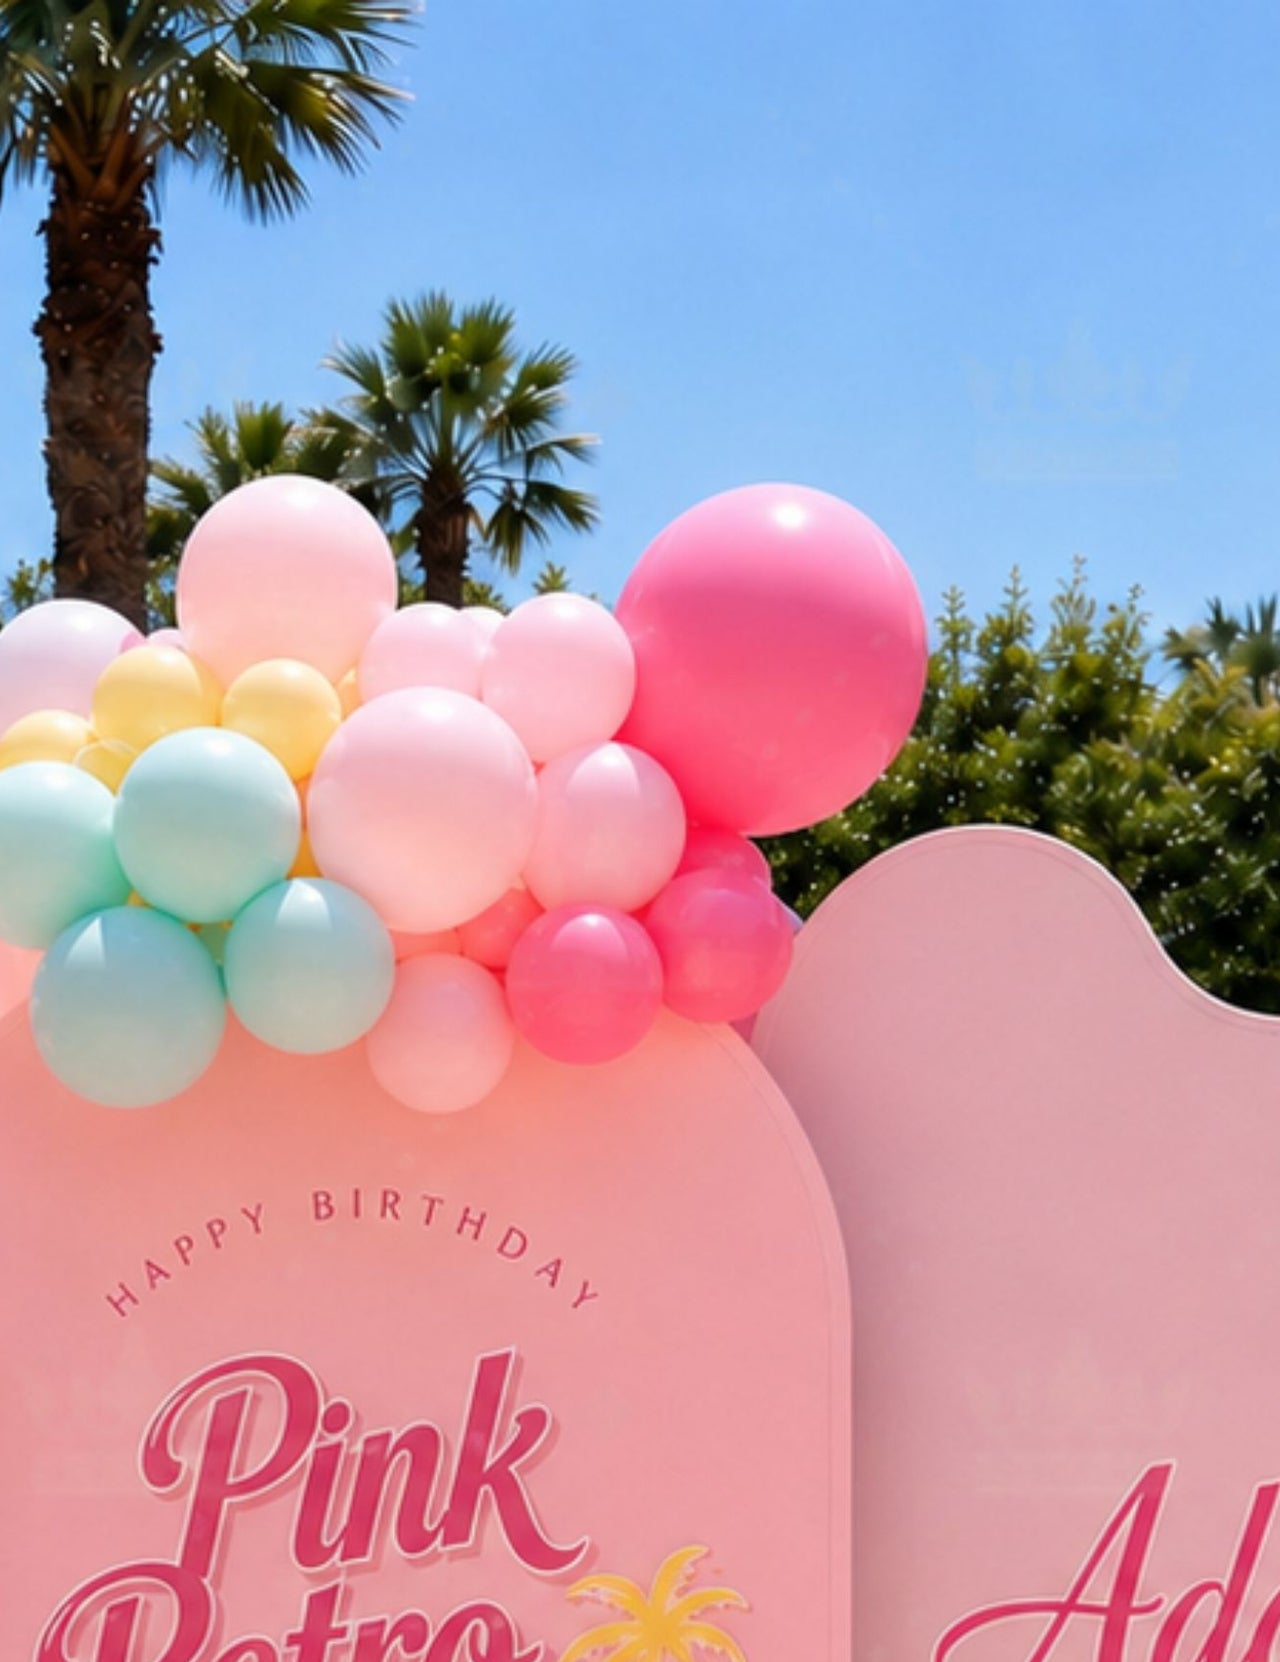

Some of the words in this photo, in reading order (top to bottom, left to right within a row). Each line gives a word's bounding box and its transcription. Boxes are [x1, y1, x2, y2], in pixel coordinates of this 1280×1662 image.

[104, 1202, 270, 1318] HAPPY
[311, 1187, 601, 1311] BIRTHDAY
[138, 1346, 589, 1580] Pink
